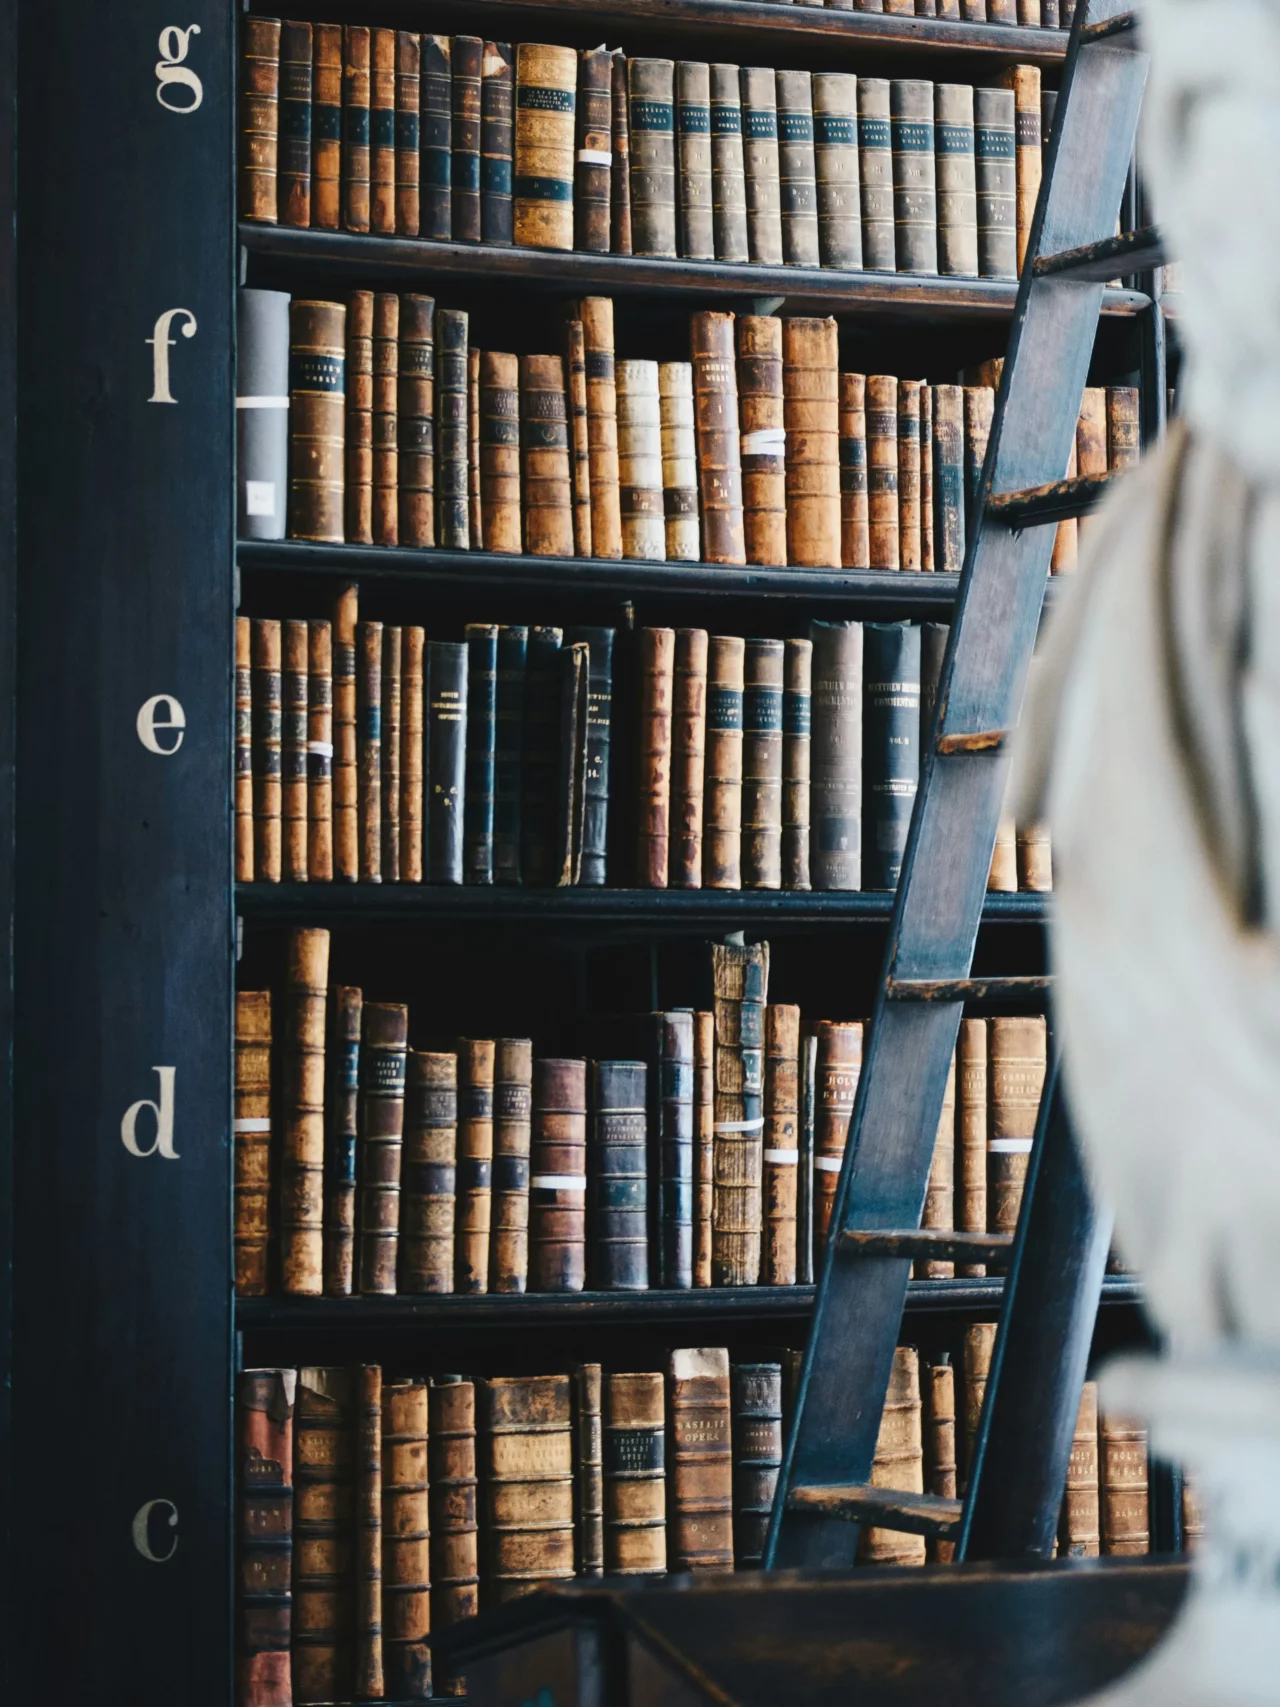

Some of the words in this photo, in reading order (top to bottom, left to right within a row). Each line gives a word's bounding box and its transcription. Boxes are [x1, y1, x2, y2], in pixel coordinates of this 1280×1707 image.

[155, 23, 204, 114] g
[145, 307, 198, 404] f
[300, 363, 341, 374] ULLER'S
[136, 694, 186, 756] e
[823, 1090, 854, 1101] BIBL
[121, 1065, 181, 1159] d
[677, 1419, 725, 1430] BASILII
[684, 1432, 720, 1442] OPERA
[1070, 1452, 1091, 1460] HOLY
[1113, 1452, 1139, 1461] HOLY
[1068, 1465, 1095, 1475] BIBLE
[1110, 1466, 1144, 1476] BIBLE
[132, 1498, 179, 1563] c
